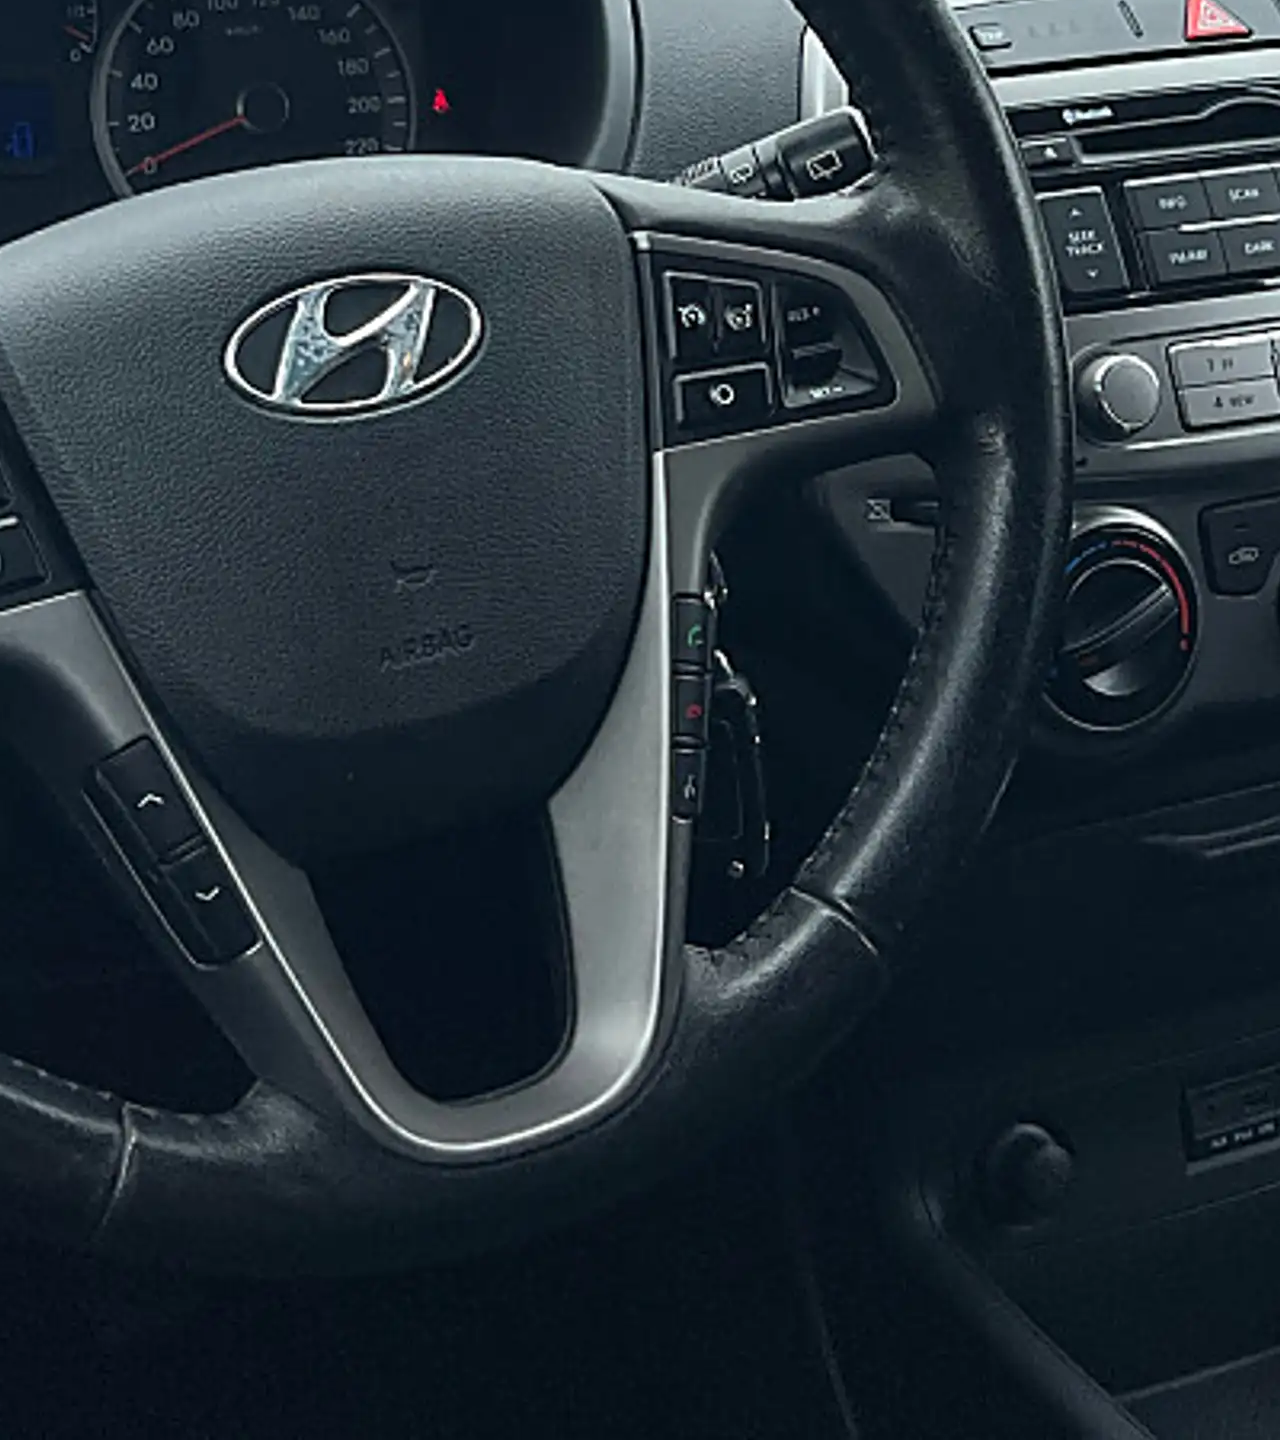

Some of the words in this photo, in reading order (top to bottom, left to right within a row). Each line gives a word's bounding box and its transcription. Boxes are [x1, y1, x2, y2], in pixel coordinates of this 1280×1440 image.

[173, 12, 200, 29] 80
[288, 5, 321, 22] 140
[318, 27, 351, 44] 160
[147, 37, 174, 56] 60
[337, 59, 369, 76] 180
[130, 73, 158, 91] 40
[348, 97, 380, 114] 200
[127, 113, 155, 133] 20
[344, 137, 380, 156] 220
